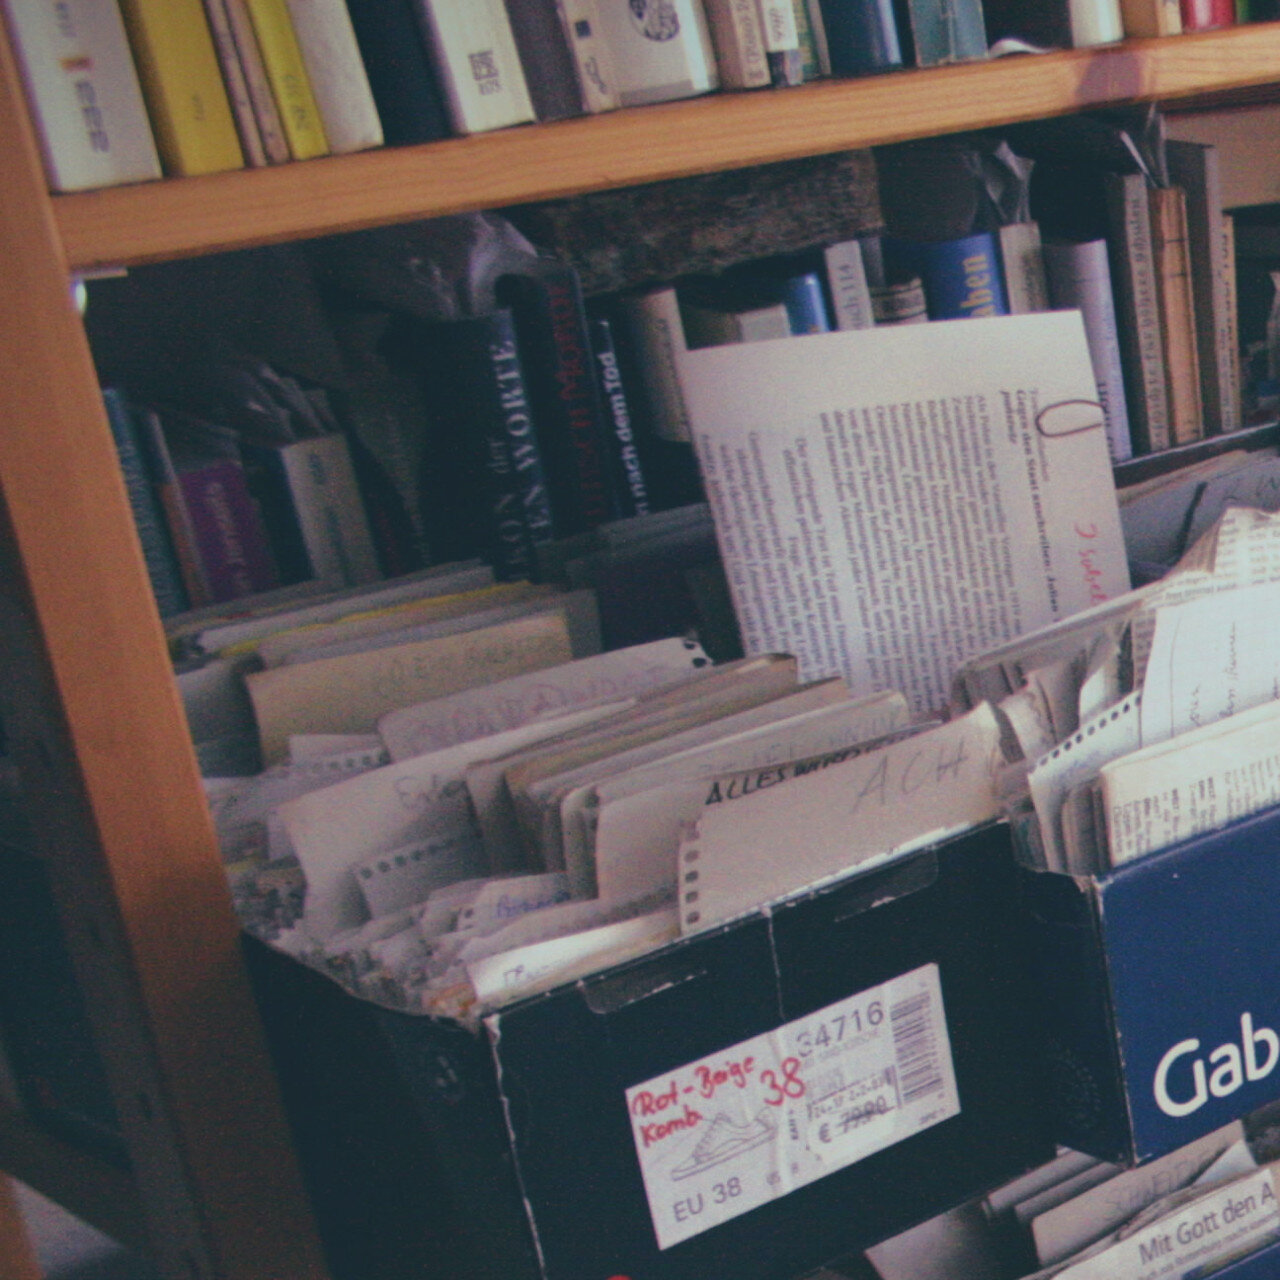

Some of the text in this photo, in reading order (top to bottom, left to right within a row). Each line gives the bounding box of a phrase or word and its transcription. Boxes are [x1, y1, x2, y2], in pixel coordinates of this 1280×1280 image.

[596, 349, 622, 393] Tod
[489, 334, 538, 474] WORTE
[607, 392, 634, 443] dem
[759, 1055, 806, 1107] 38
[672, 1175, 743, 1224] EU 38
[1137, 1233, 1175, 1266] Mit
[1176, 1209, 1221, 1246] Gott
[1221, 1195, 1257, 1226] den
